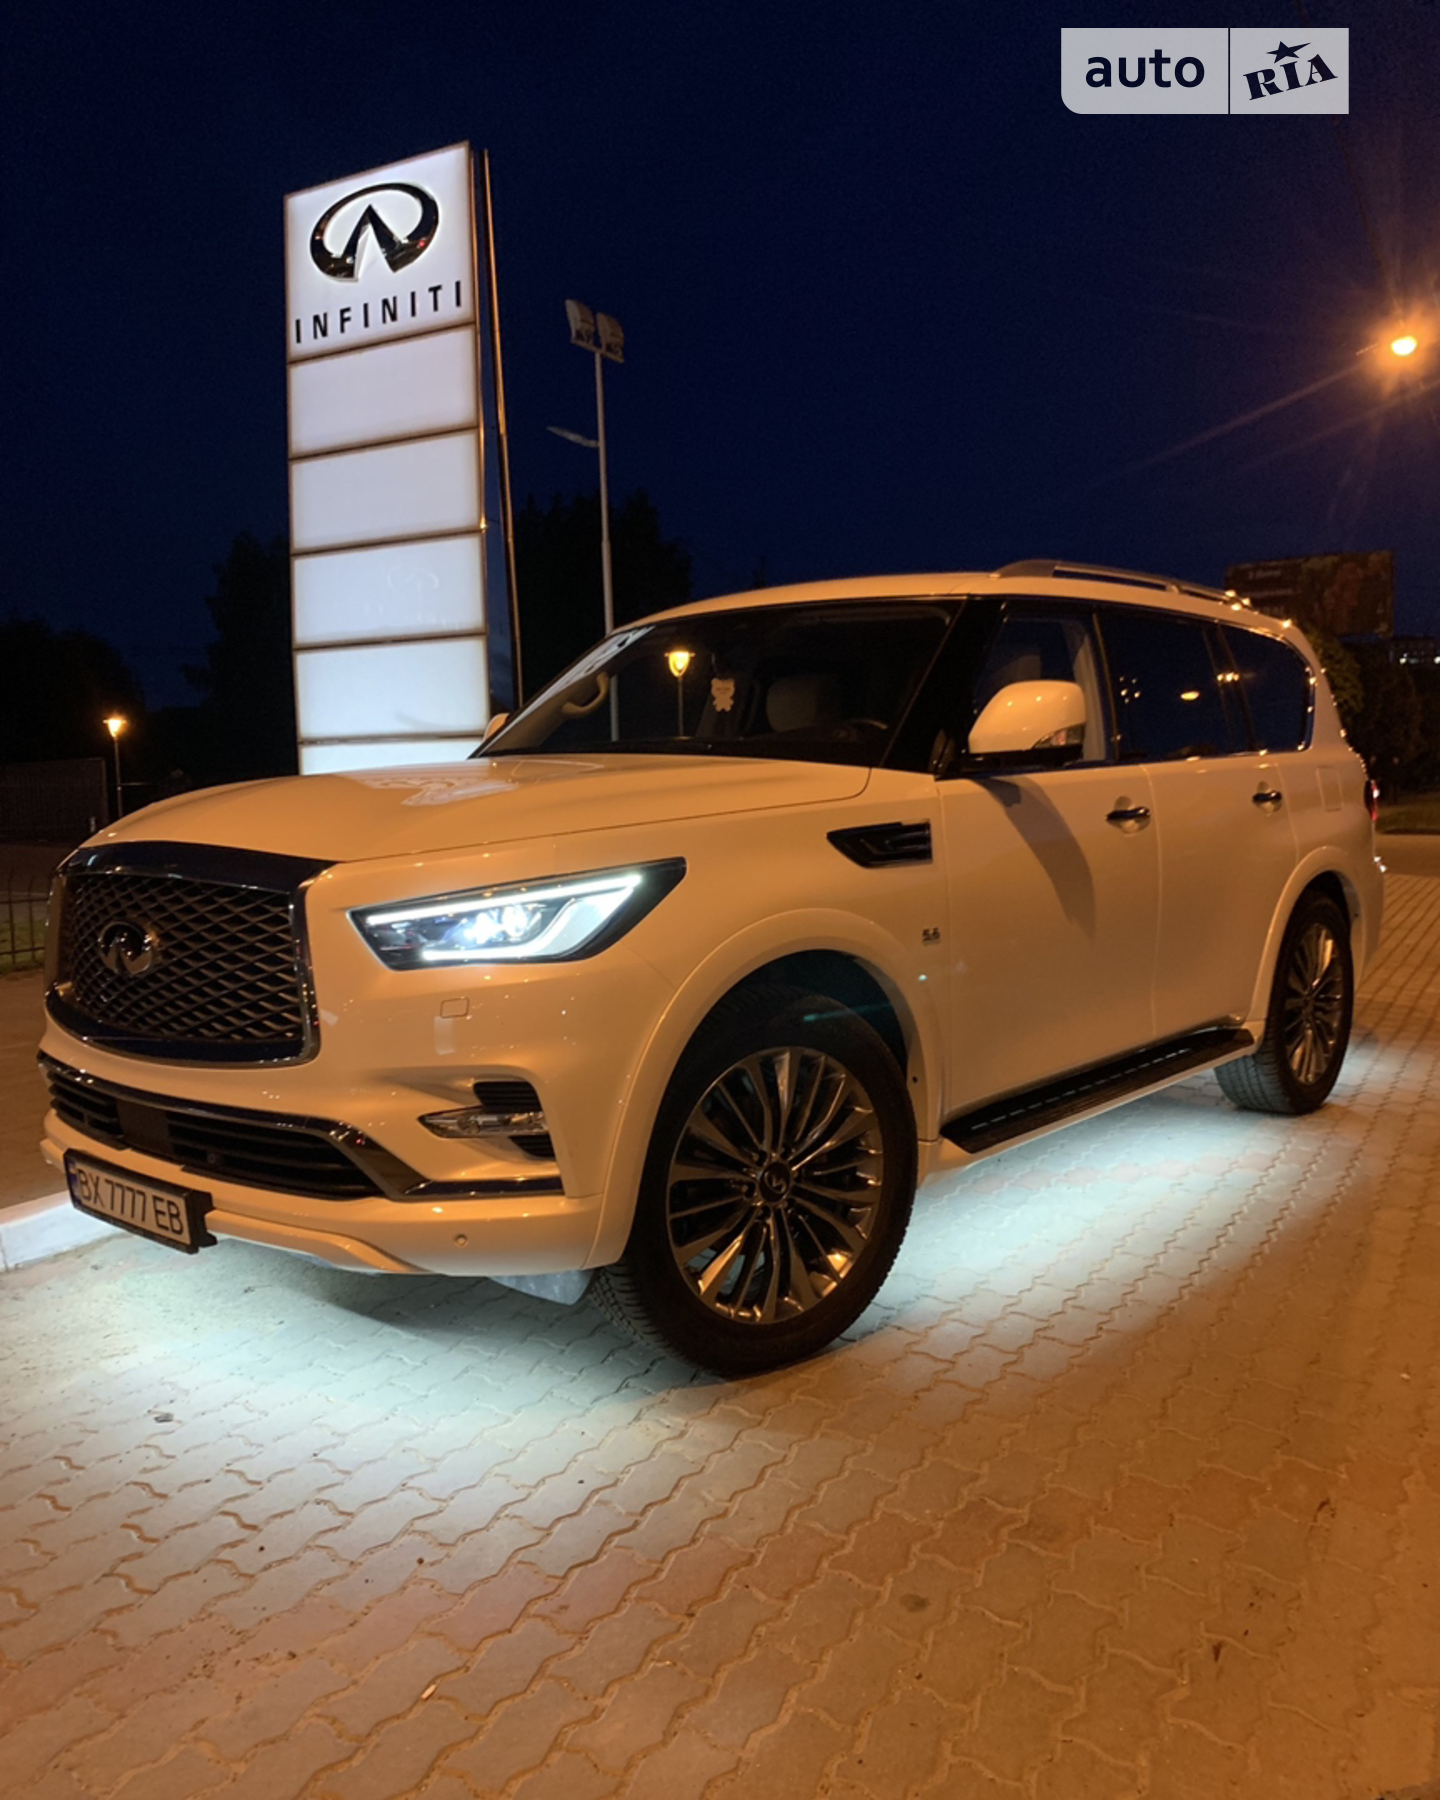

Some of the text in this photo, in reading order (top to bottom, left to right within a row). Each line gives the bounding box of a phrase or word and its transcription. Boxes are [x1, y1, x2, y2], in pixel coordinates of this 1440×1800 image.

[295, 280, 462, 344] INFINITI
[104, 1178, 147, 1223] 7777
[152, 1195, 184, 1236] EB
